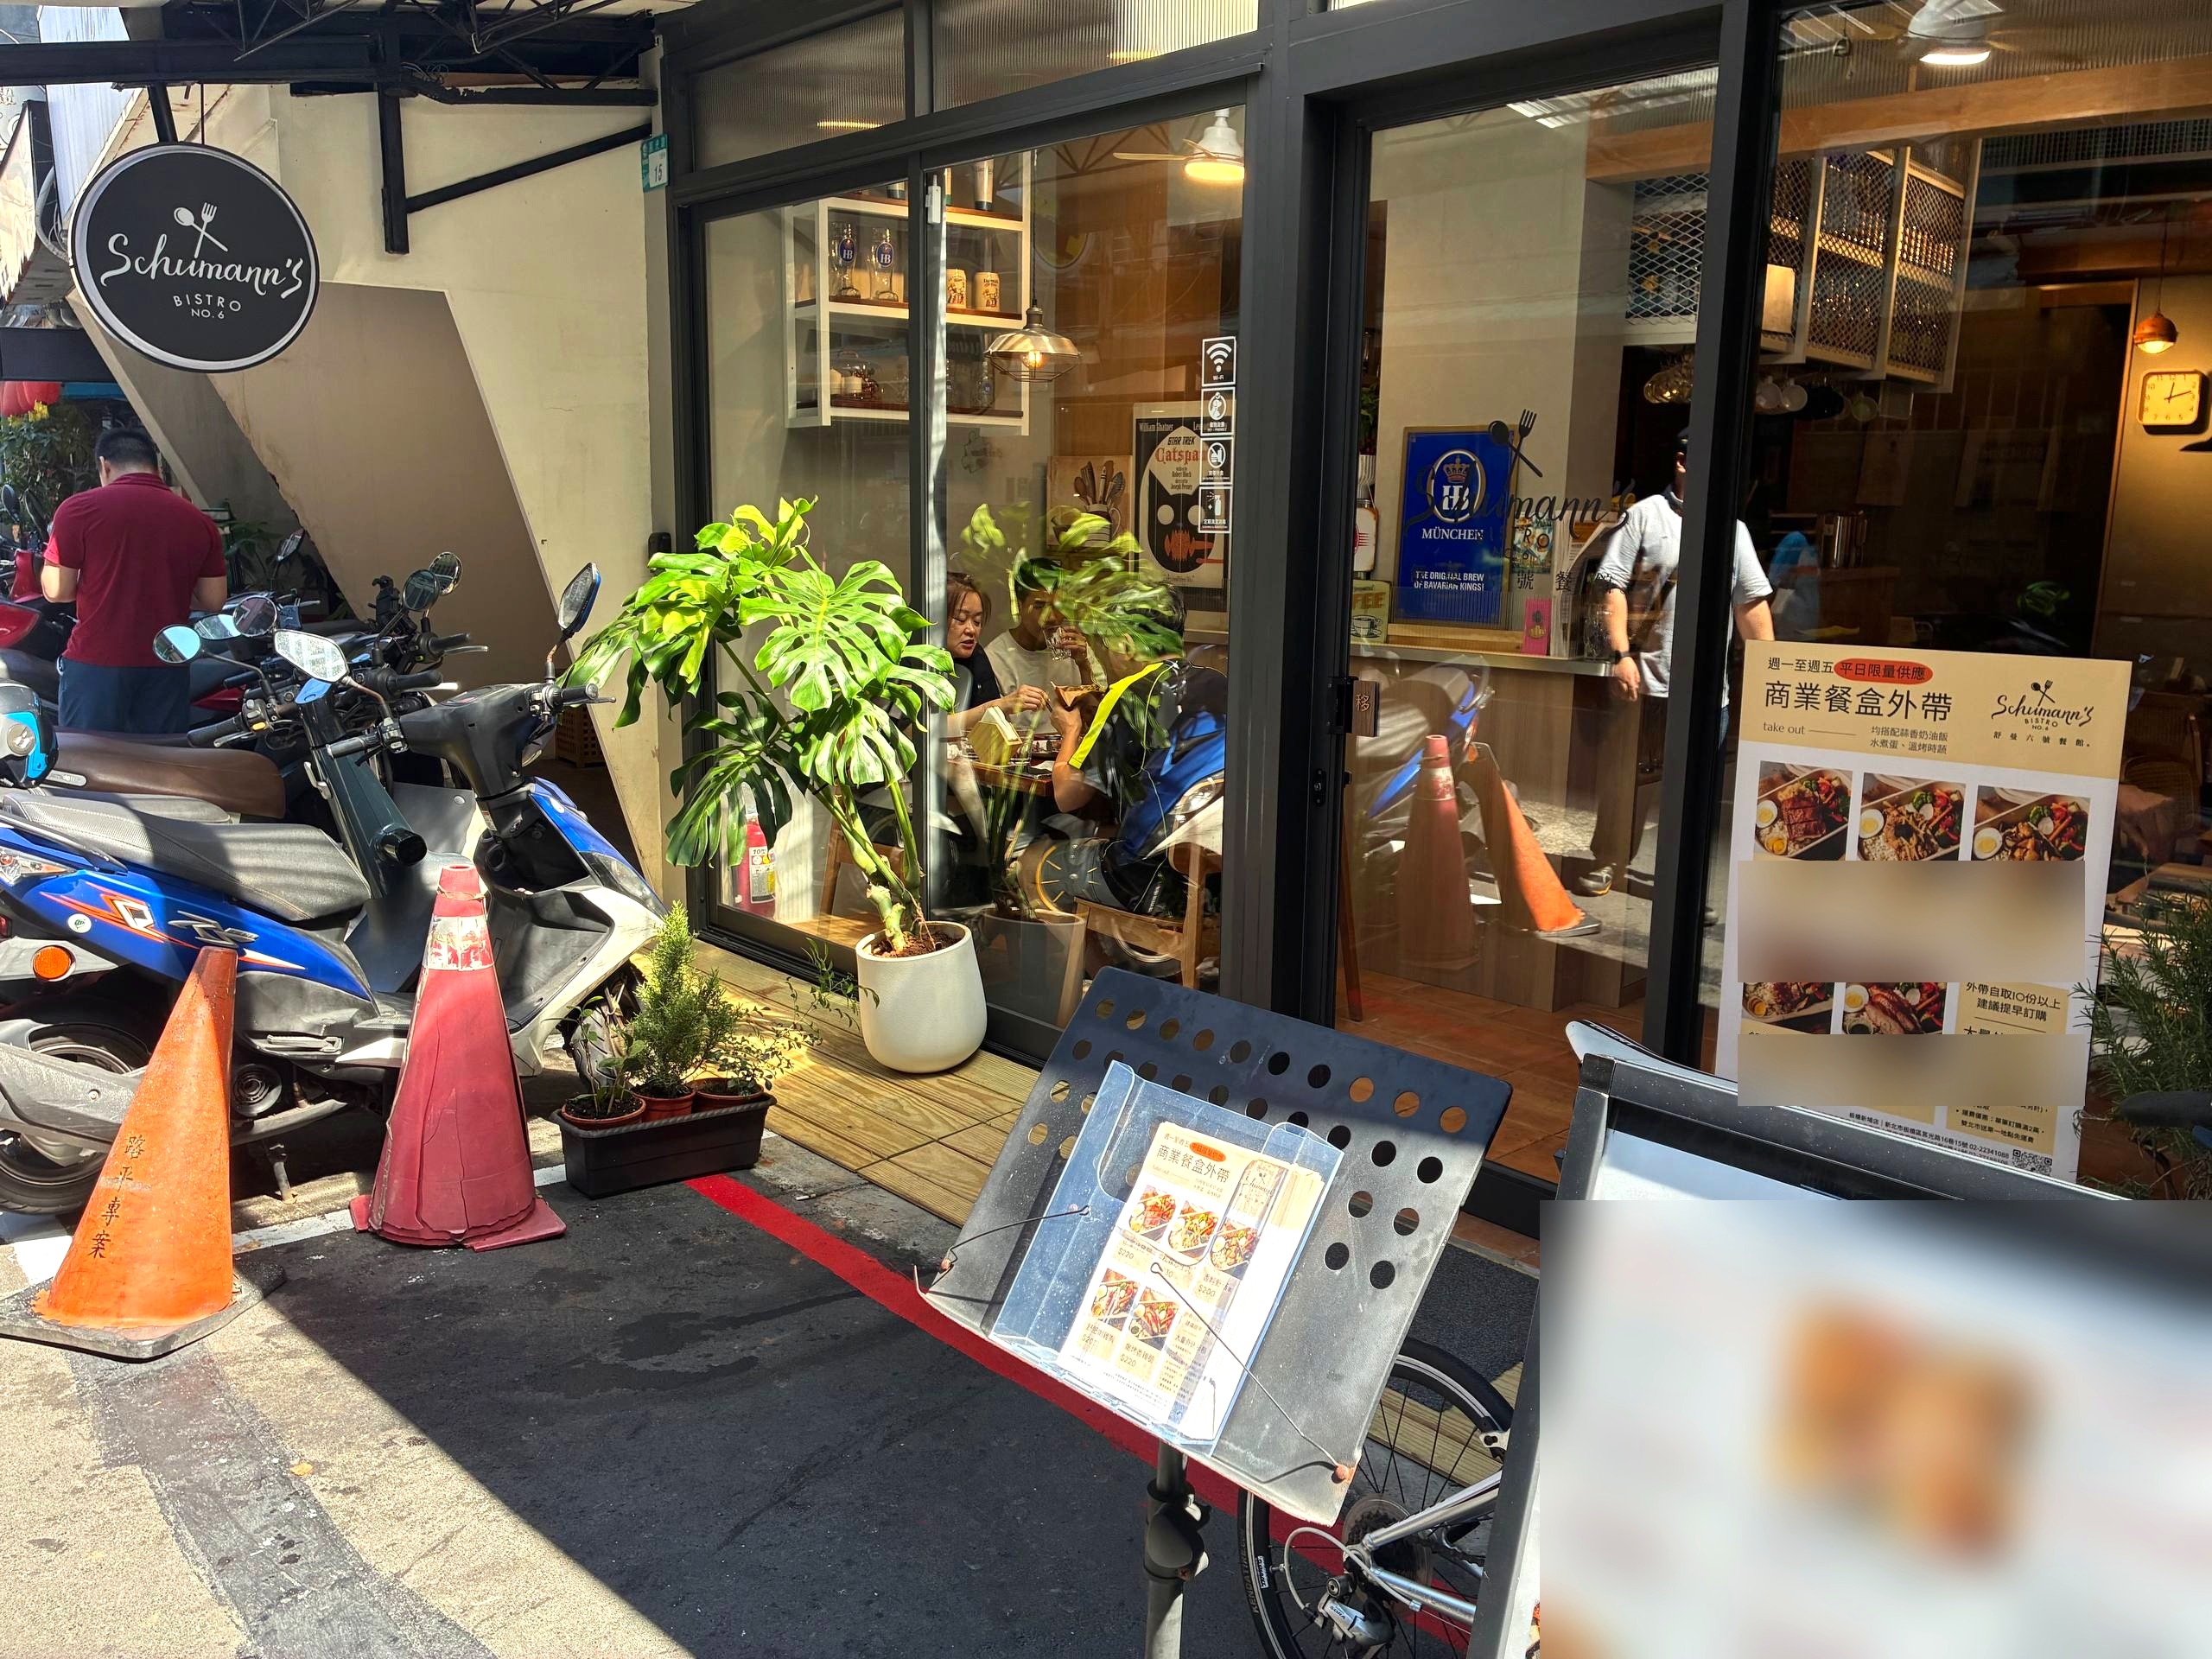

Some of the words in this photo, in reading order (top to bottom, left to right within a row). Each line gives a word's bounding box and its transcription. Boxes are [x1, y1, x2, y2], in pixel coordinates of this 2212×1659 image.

[654, 163, 663, 182] 15
[842, 249, 853, 259] HB
[880, 253, 891, 264] HB
[100, 233, 303, 299] Schumann's
[173, 293, 242, 312] BISTRO
[1167, 436, 1181, 446] STAR
[1182, 435, 1196, 445] TREK
[1421, 526, 1484, 541] MÜNCHEN
[1463, 572, 1484, 582] BREW
[1768, 657, 1834, 675] 週一至週五
[1840, 662, 1926, 681] 平日限量供應
[1765, 680, 1952, 722] 商業餐盒外帶
[1991, 694, 2094, 728] Schumann's
[1764, 721, 1785, 734] take
[1788, 724, 1806, 735] out
[2024, 717, 2058, 728] BISTRO
[1871, 725, 1948, 742] 均搭配蒜香奶油飯
[1976, 997, 2047, 1022] 建議提早訂購
[1157, 1144, 1230, 1183] 商業餐盒外帶
[88, 1135, 145, 1259] 路平專案
[1117, 1248, 1134, 1260] $220
[1120, 1353, 1137, 1368] $220
